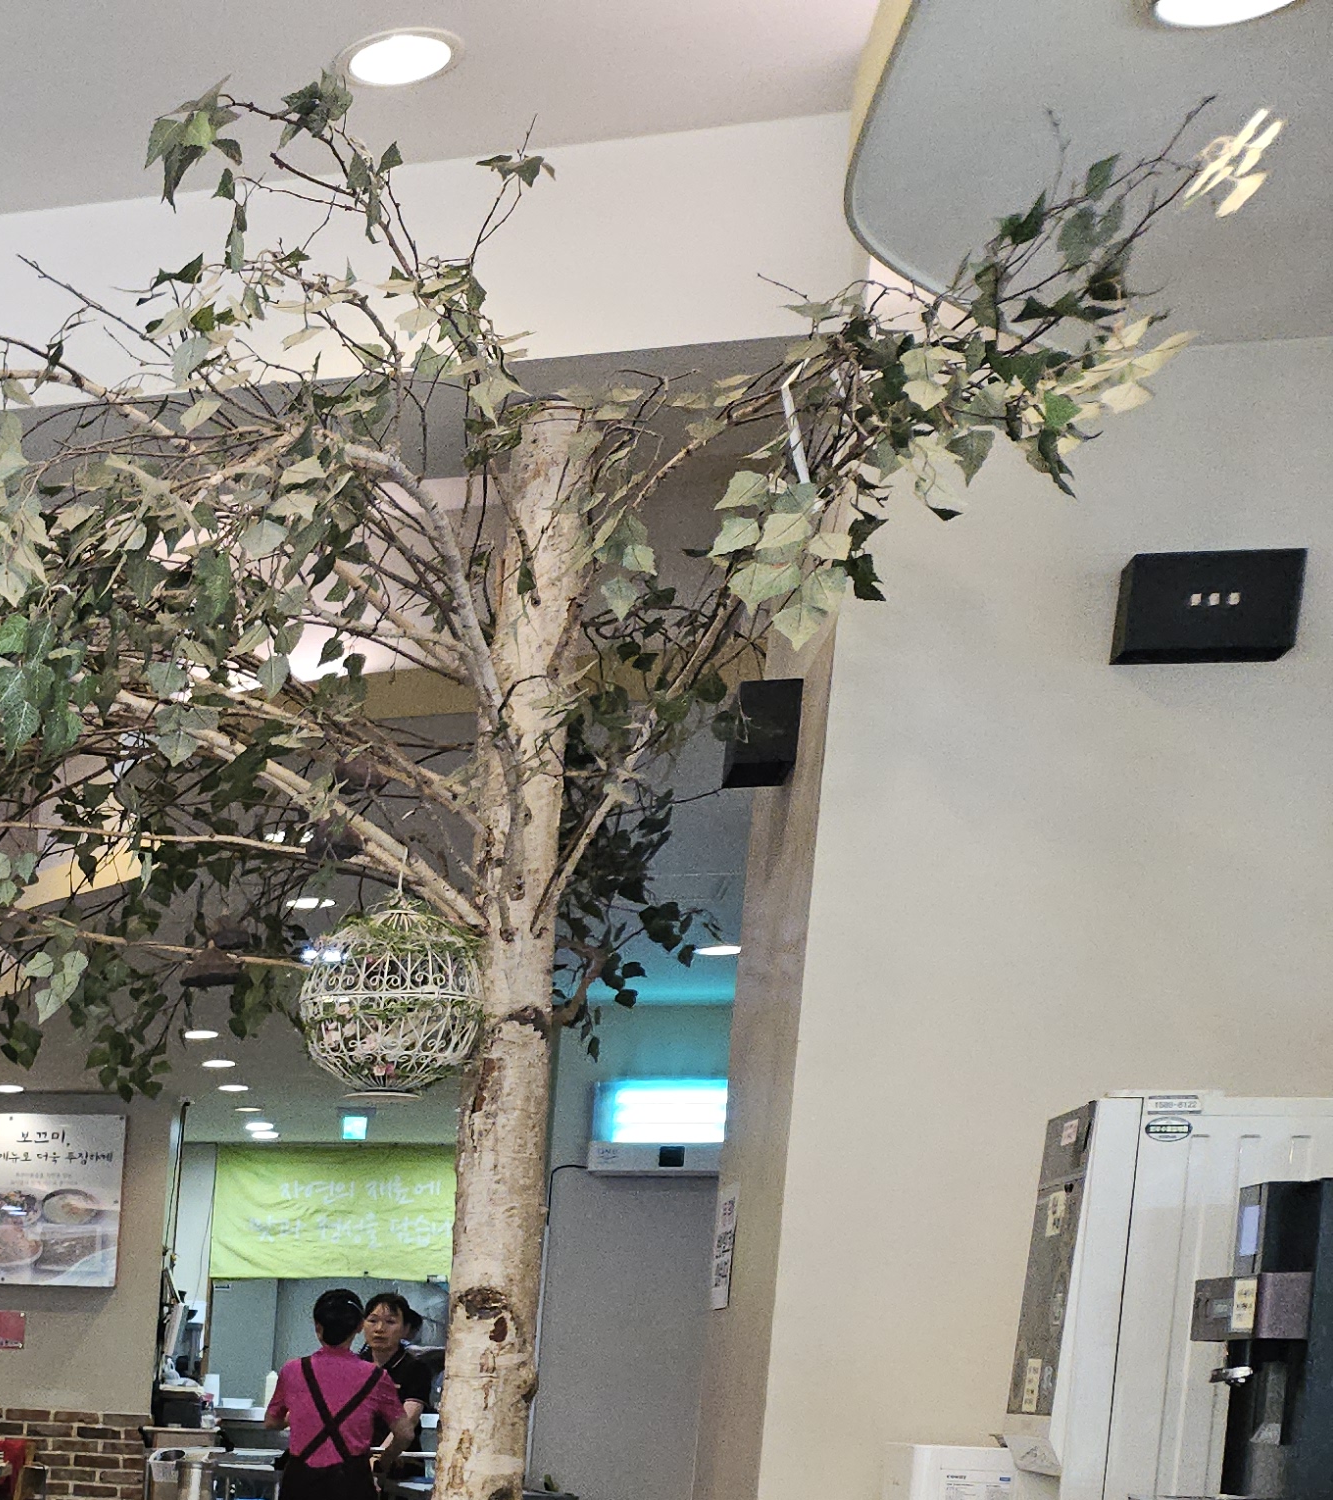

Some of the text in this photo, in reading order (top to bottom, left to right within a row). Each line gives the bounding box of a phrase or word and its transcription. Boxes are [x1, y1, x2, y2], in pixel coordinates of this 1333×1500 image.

[16, 1129, 71, 1147] 보끄미,
[279, 1180, 355, 1205] 자연의
[389, 1214, 454, 1248] 담습니
